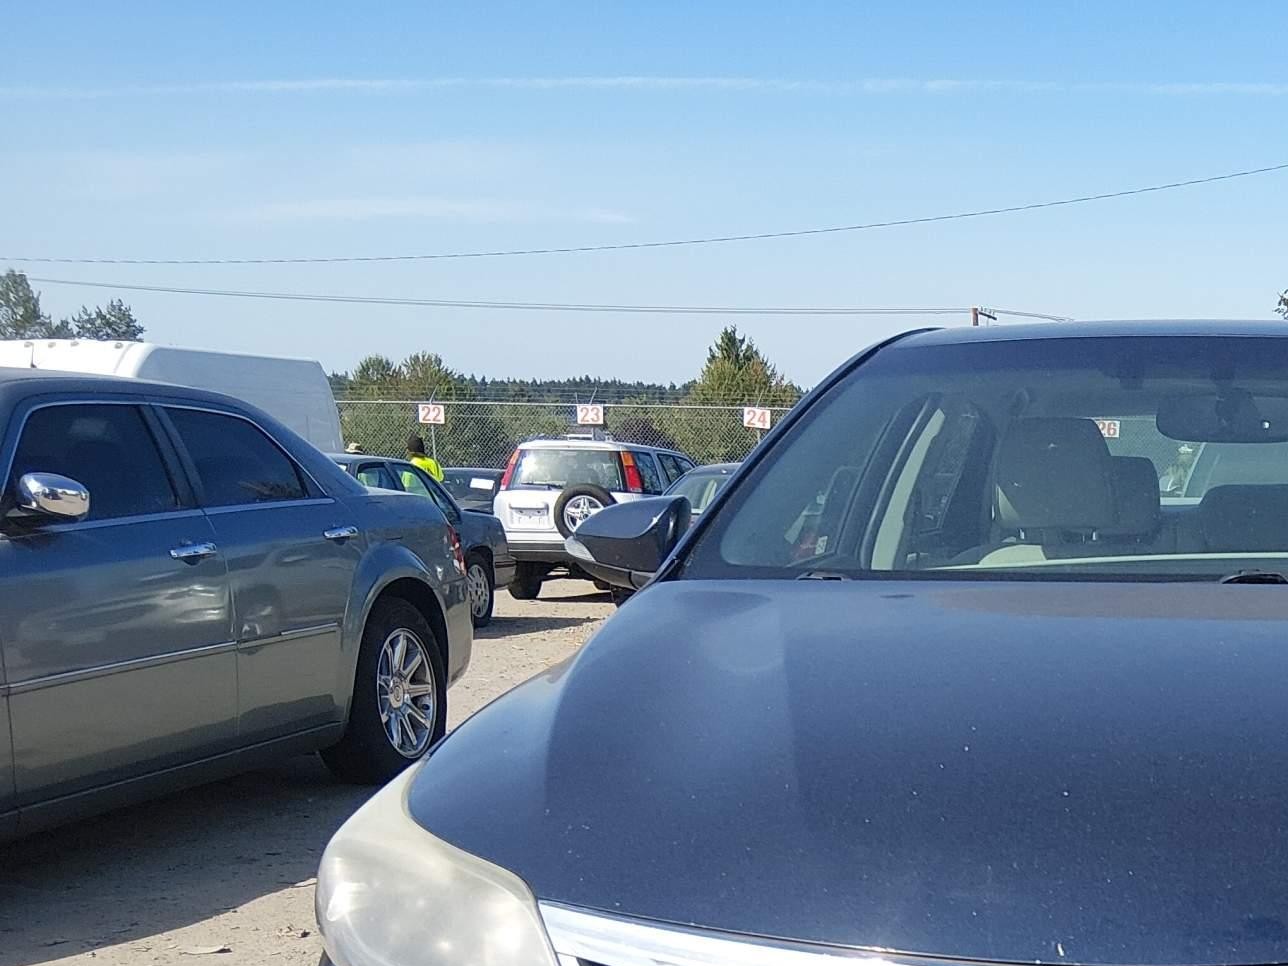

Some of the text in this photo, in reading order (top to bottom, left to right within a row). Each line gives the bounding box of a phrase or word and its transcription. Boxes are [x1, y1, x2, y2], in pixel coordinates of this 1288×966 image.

[421, 406, 442, 422] 22
[580, 406, 601, 423] 23
[747, 410, 769, 427] 24
